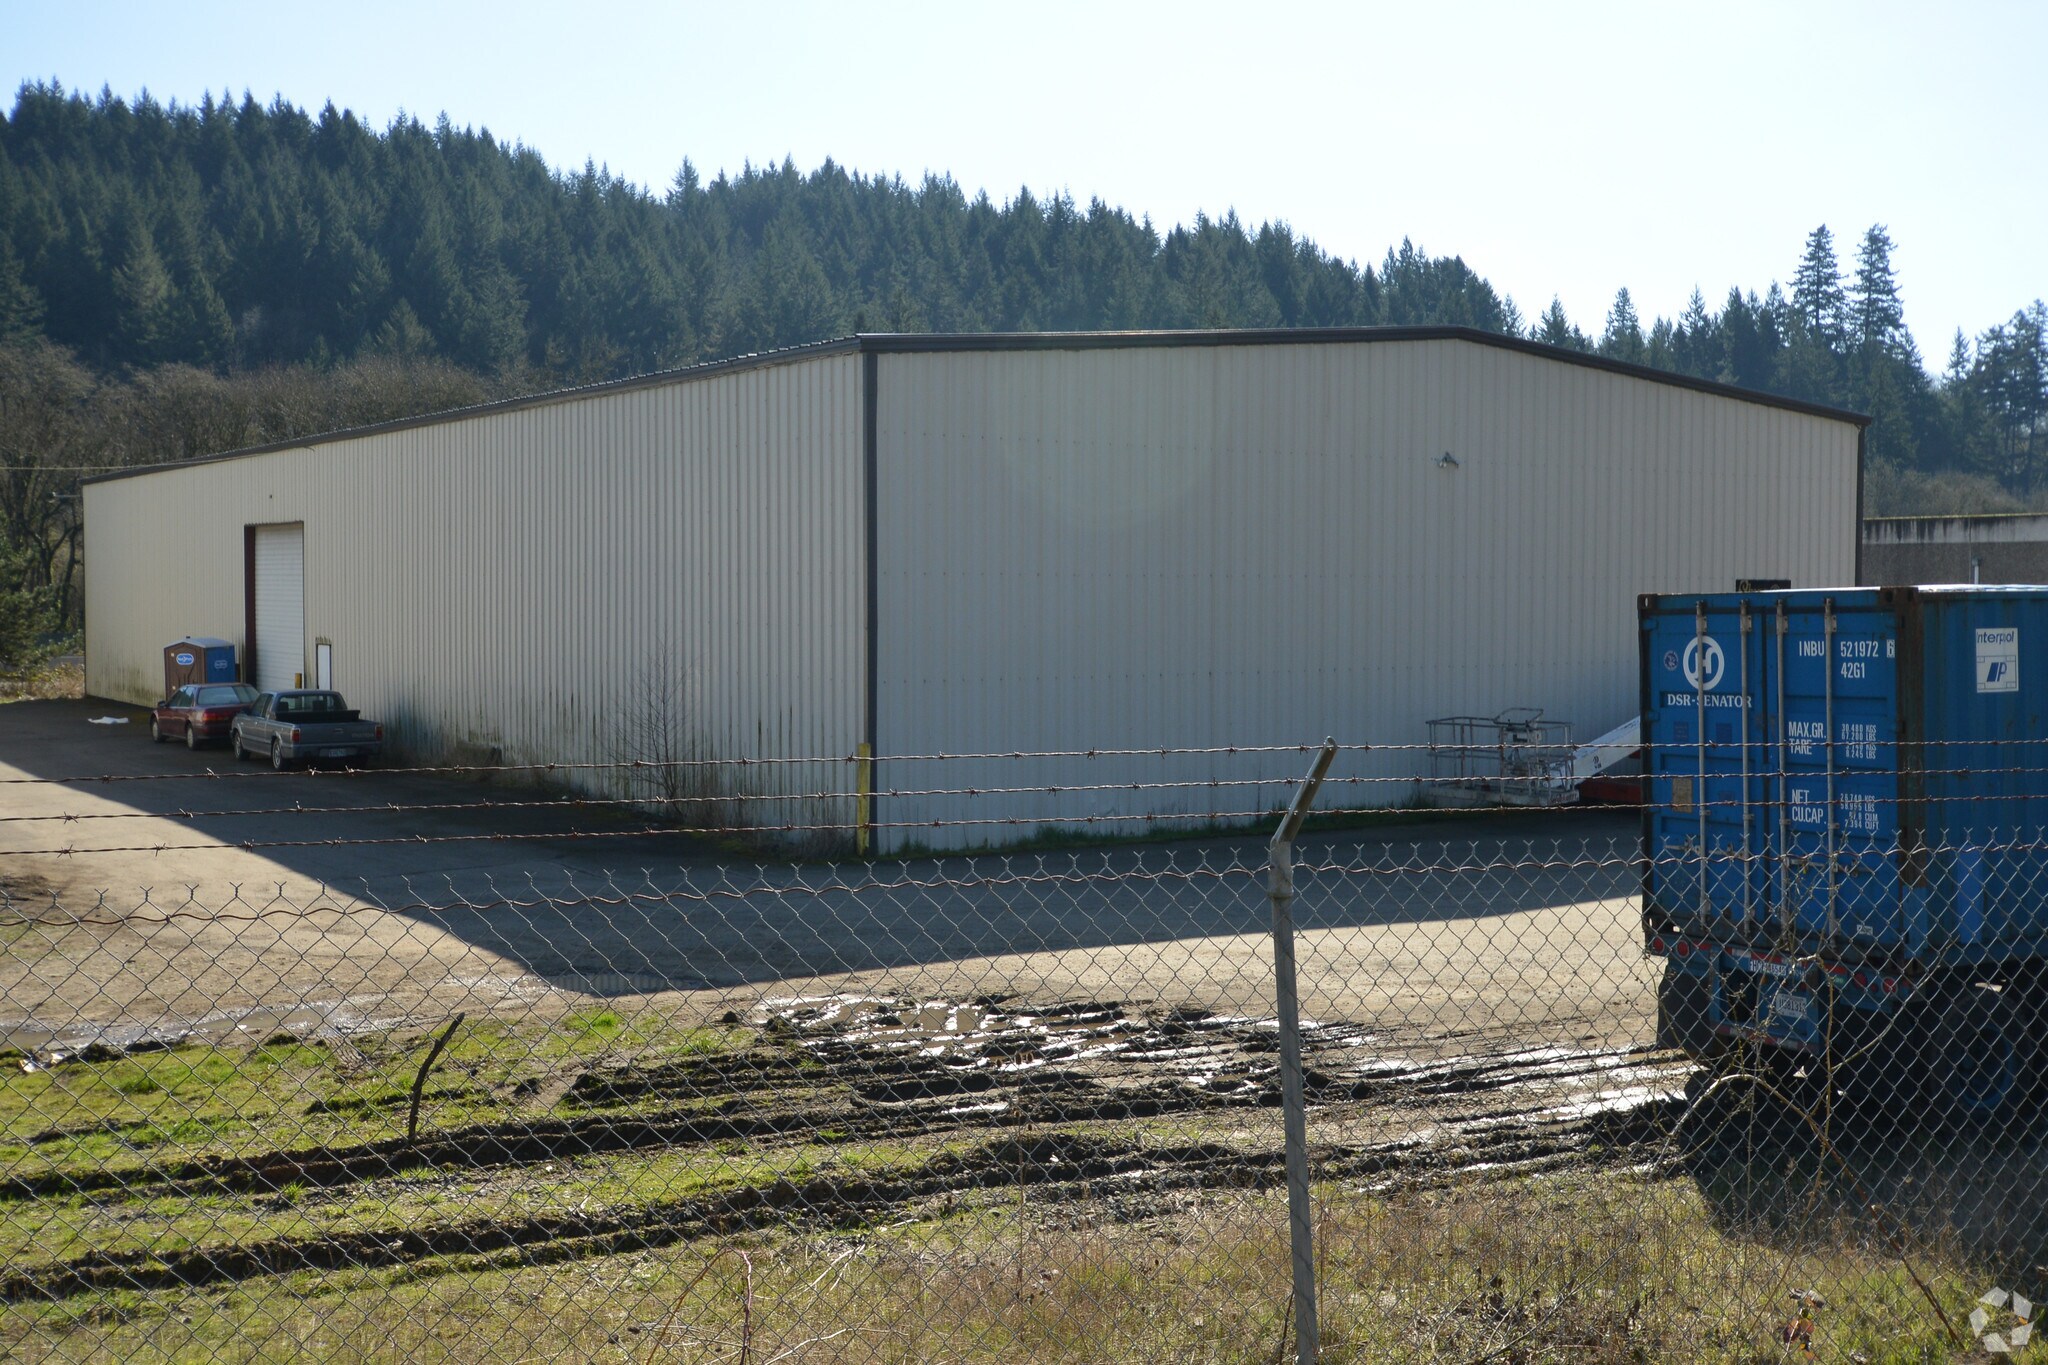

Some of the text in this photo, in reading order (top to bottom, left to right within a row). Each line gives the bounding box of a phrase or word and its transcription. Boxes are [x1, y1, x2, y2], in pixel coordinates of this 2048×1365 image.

[1799, 640, 1895, 658] INBU 521972 6
[1841, 662, 1865, 679] 42G1
[1788, 738, 1812, 755] TARE
[1792, 788, 1809, 805] NET
